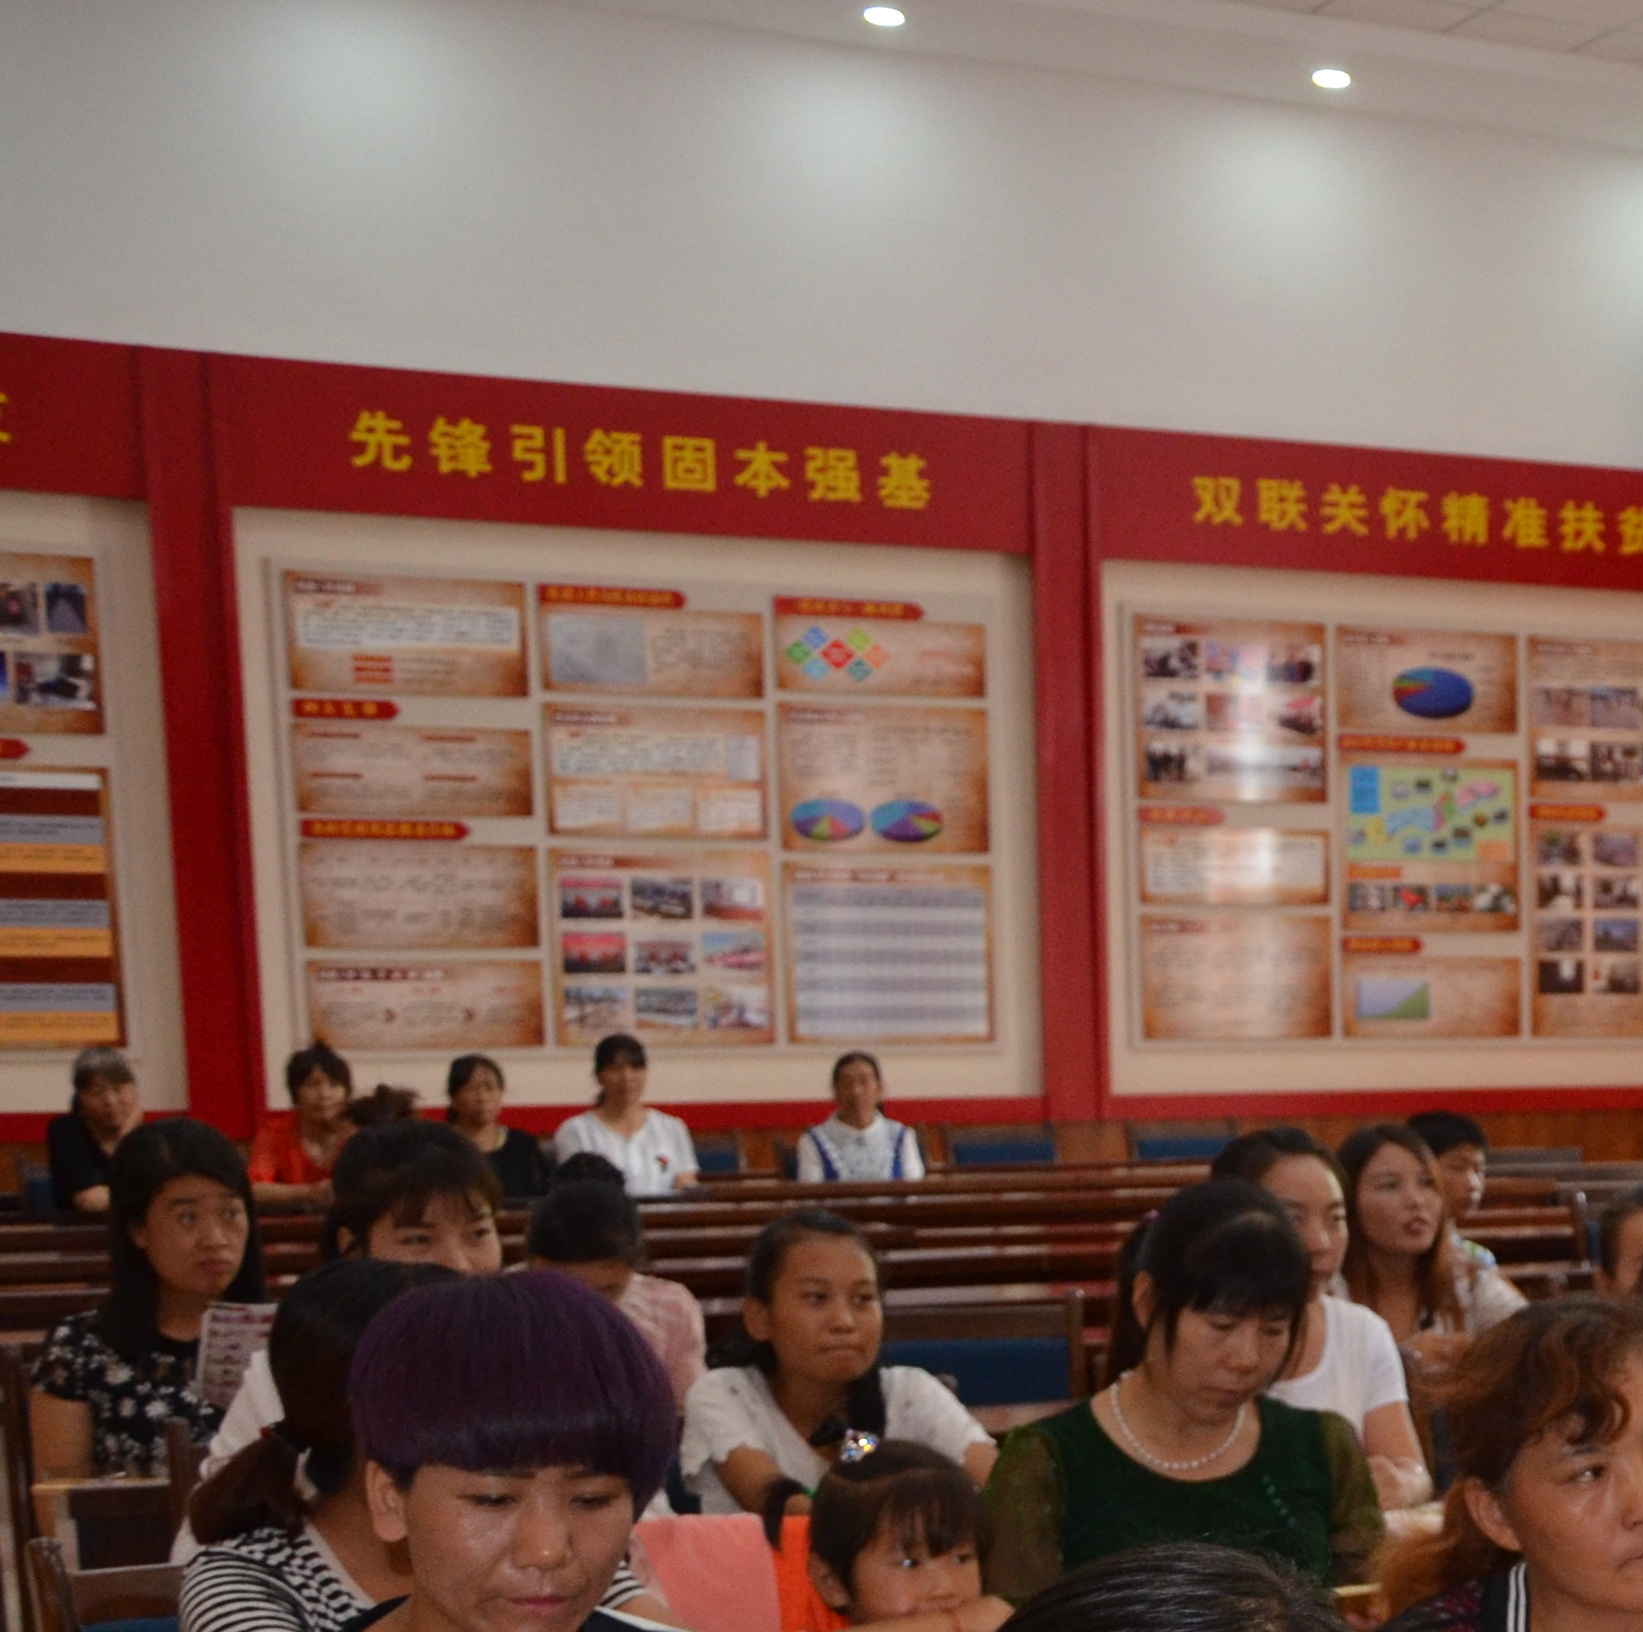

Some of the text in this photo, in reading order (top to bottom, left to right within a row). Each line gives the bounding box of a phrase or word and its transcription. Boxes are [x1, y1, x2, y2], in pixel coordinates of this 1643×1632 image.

[350, 410, 931, 510] 先锋引领固本强基
